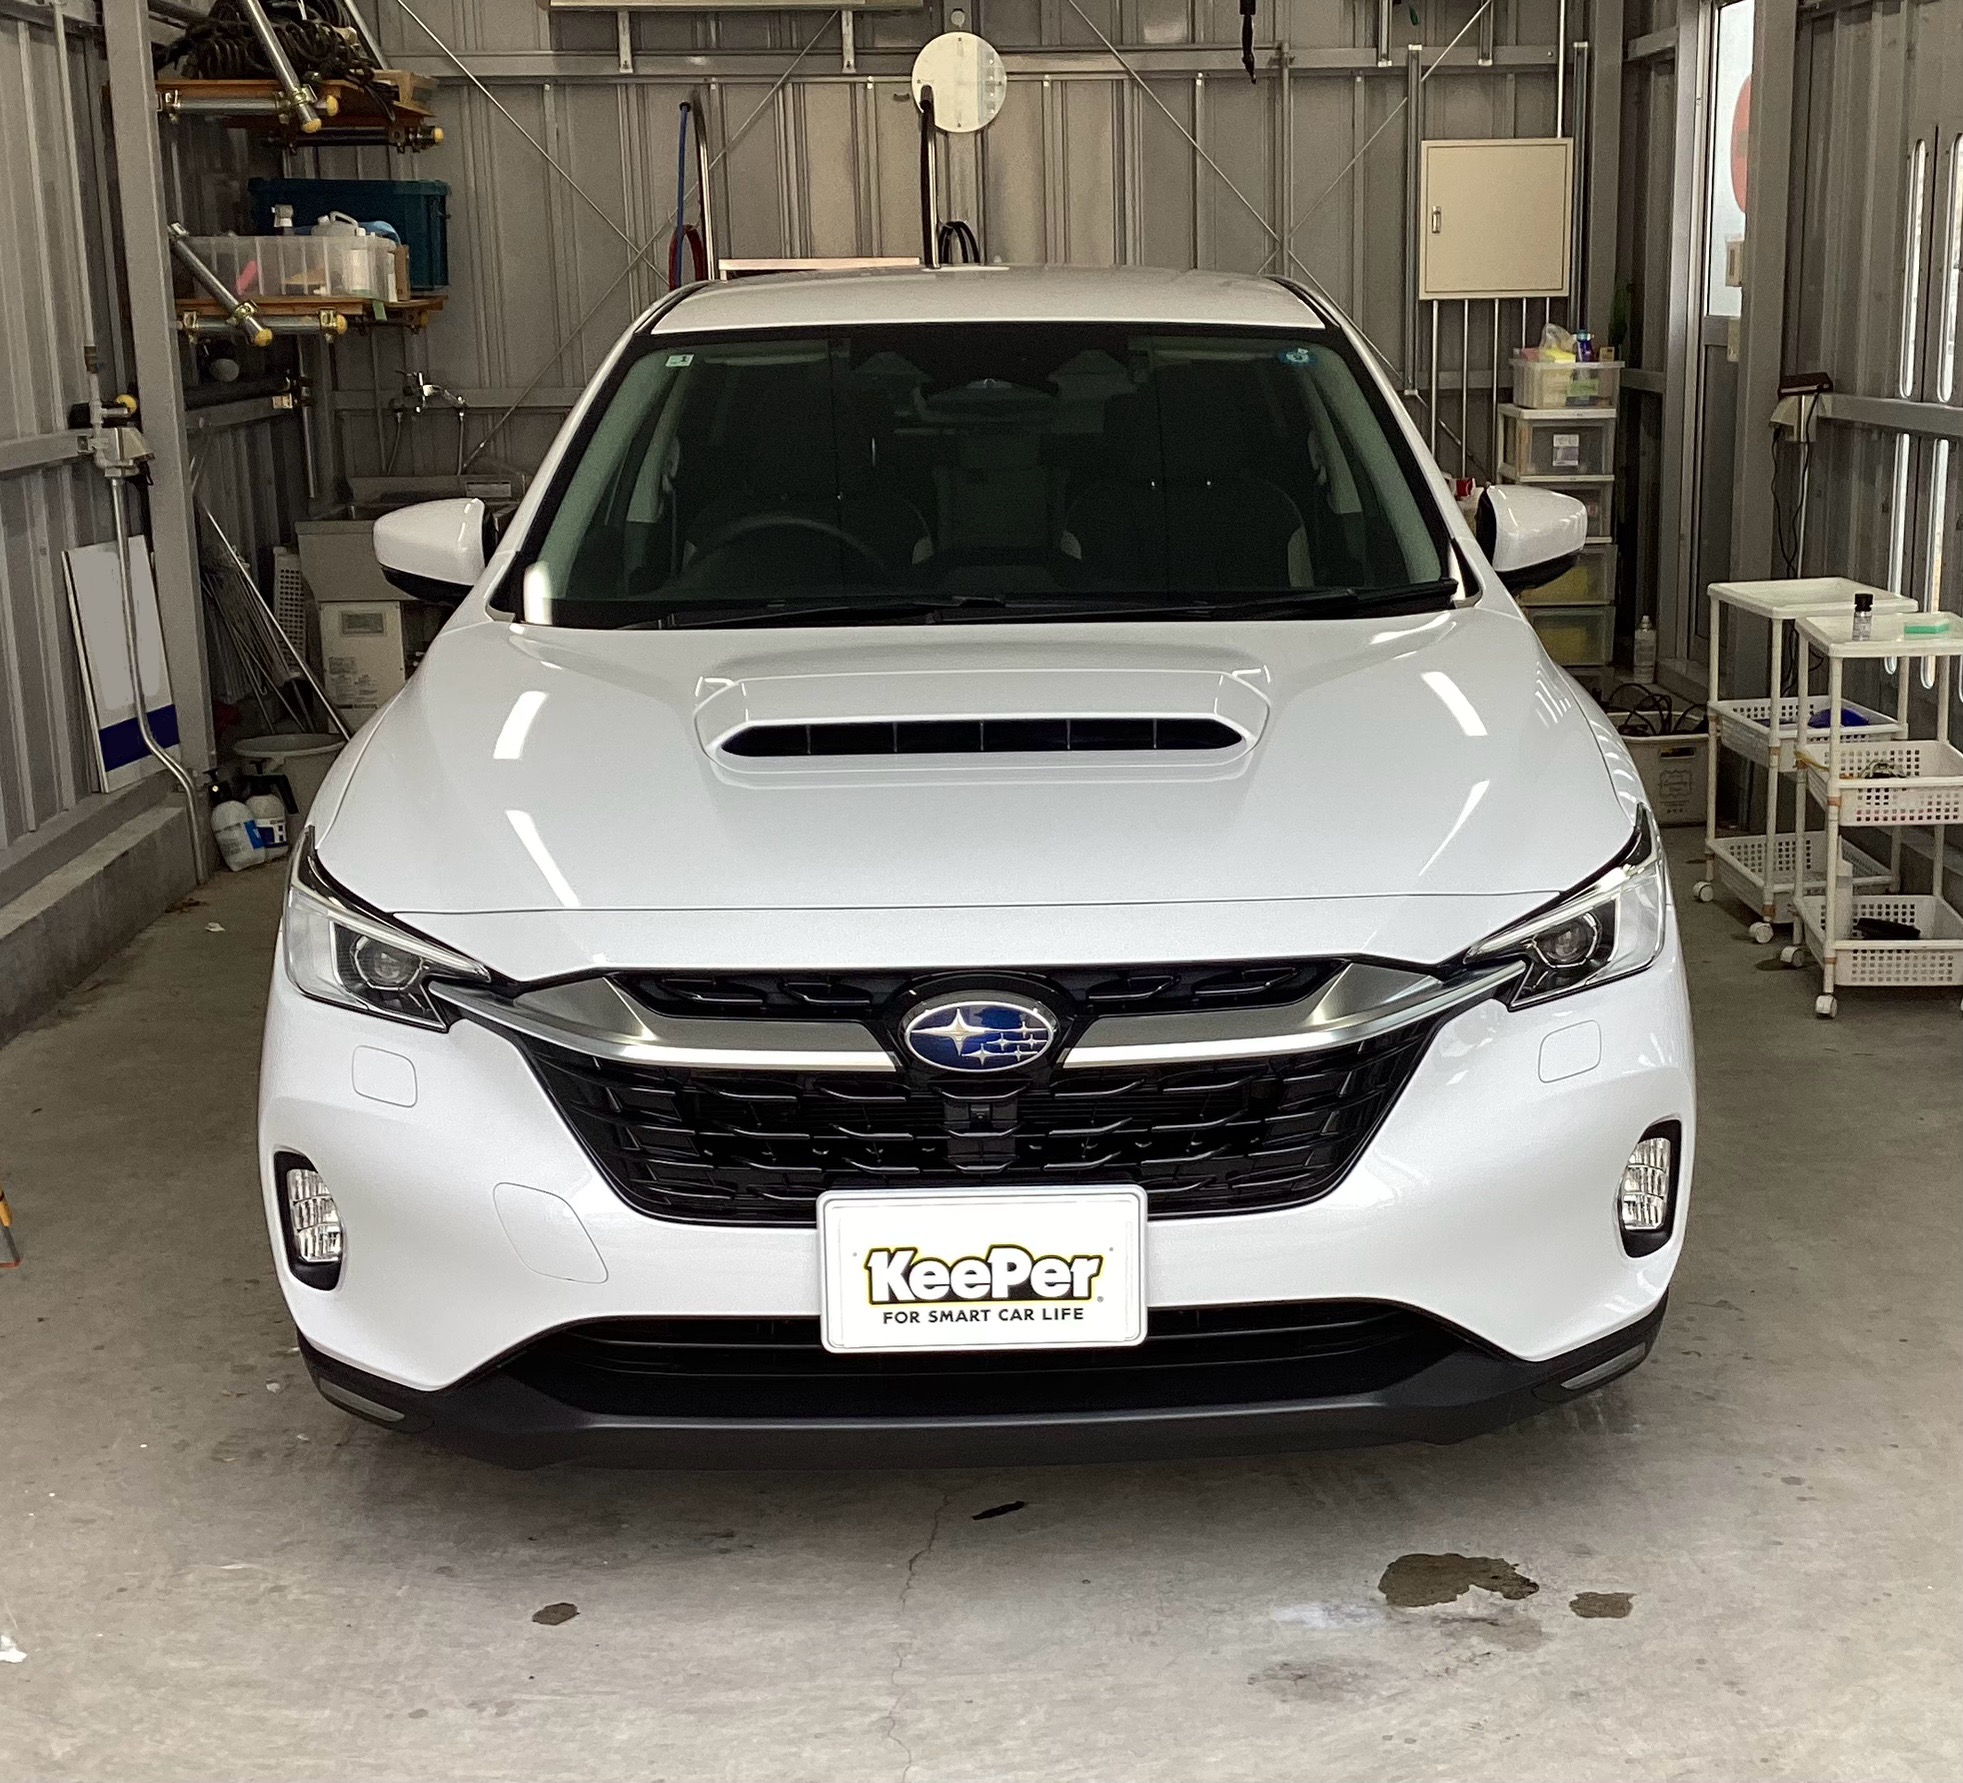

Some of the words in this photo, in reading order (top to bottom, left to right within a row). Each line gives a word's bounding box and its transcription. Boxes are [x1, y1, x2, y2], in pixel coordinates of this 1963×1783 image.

[864, 1244, 1103, 1304] KeePer
[883, 1311, 921, 1325] FOR
[929, 1309, 991, 1324] SMART
[998, 1308, 1035, 1322] CAR
[1042, 1307, 1084, 1321] LIFE
